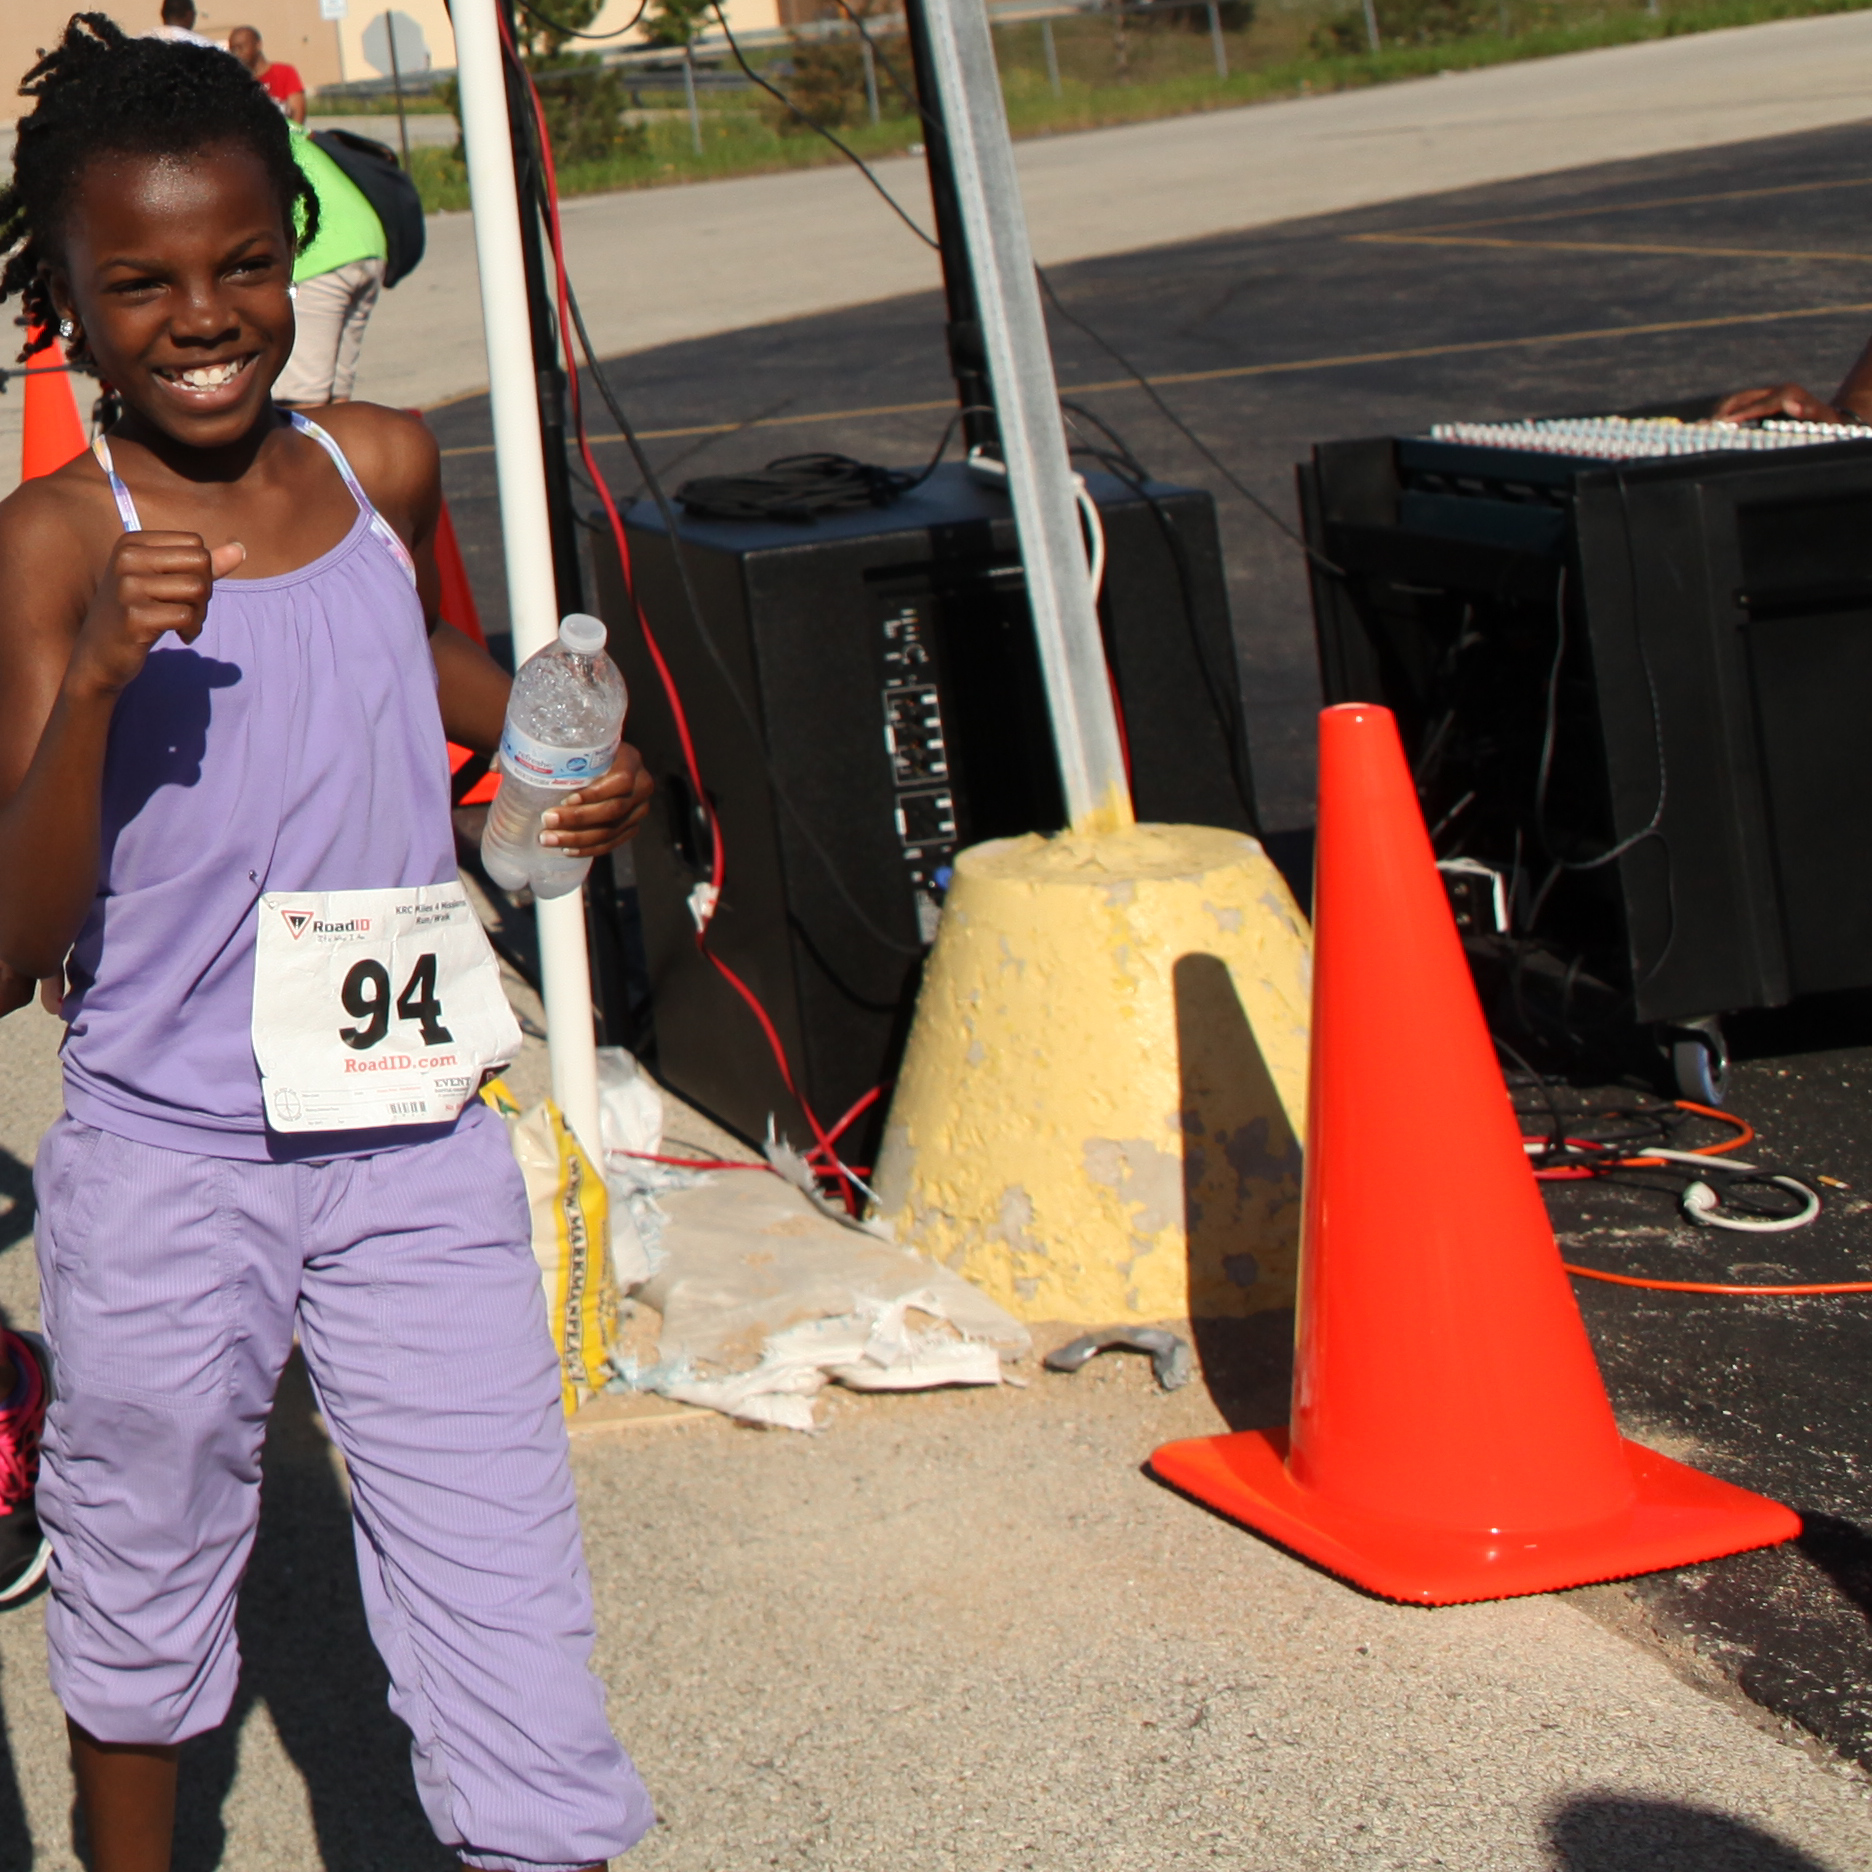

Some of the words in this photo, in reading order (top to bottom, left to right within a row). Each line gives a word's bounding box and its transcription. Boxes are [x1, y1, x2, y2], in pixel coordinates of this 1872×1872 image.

[313, 918, 371, 933] RoadID
[338, 952, 455, 1050] 94
[344, 1054, 458, 1074] RoadID.com
